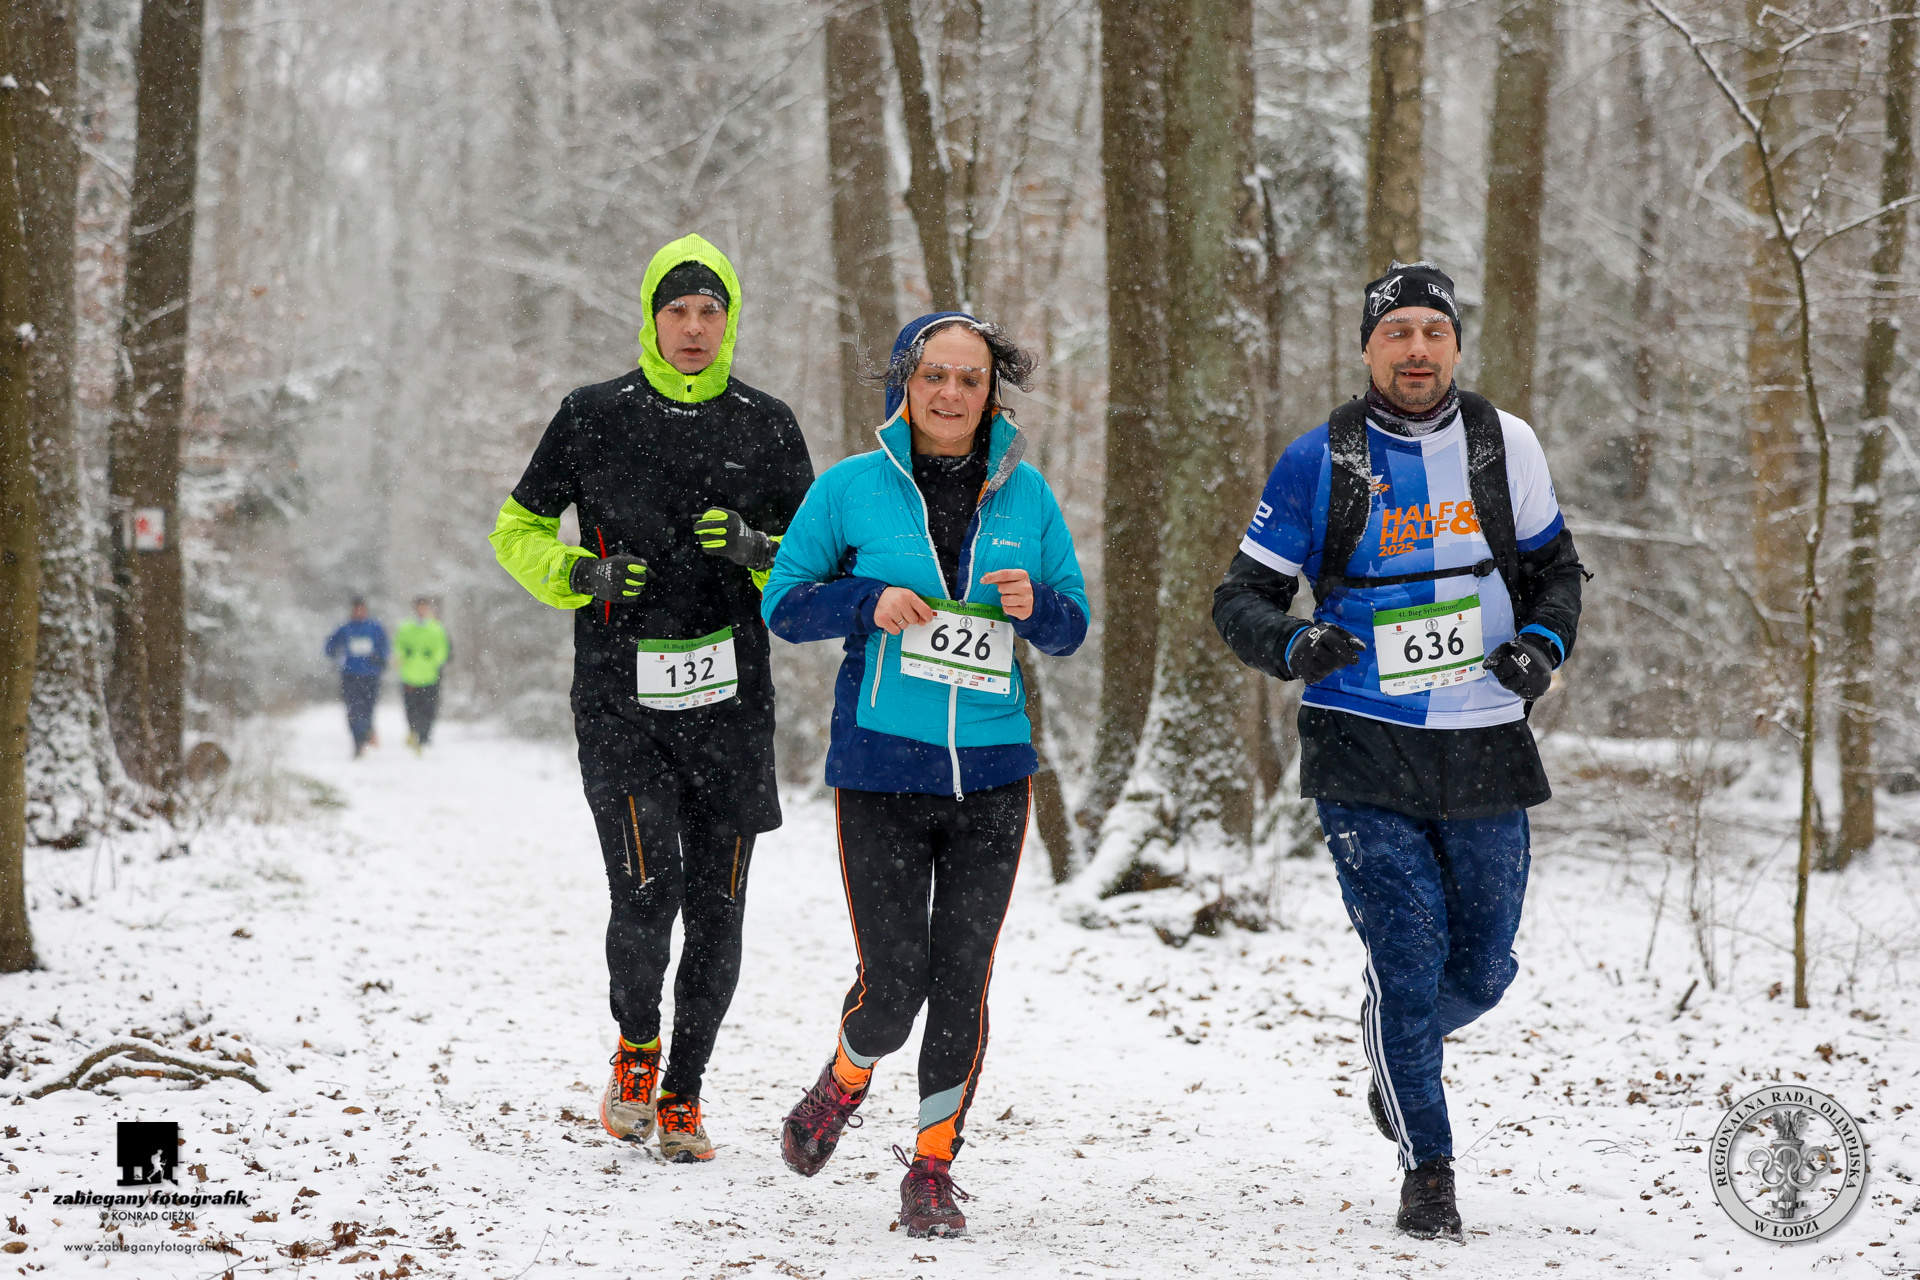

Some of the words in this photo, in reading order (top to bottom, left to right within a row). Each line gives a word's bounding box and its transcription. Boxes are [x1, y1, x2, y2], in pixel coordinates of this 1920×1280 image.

[1382, 501, 1454, 528] HALF
[1379, 520, 1450, 545] HALF
[1378, 542, 1415, 557] 2025
[931, 624, 991, 661] 626
[1404, 627, 1464, 664] 636
[666, 657, 715, 688] 132
